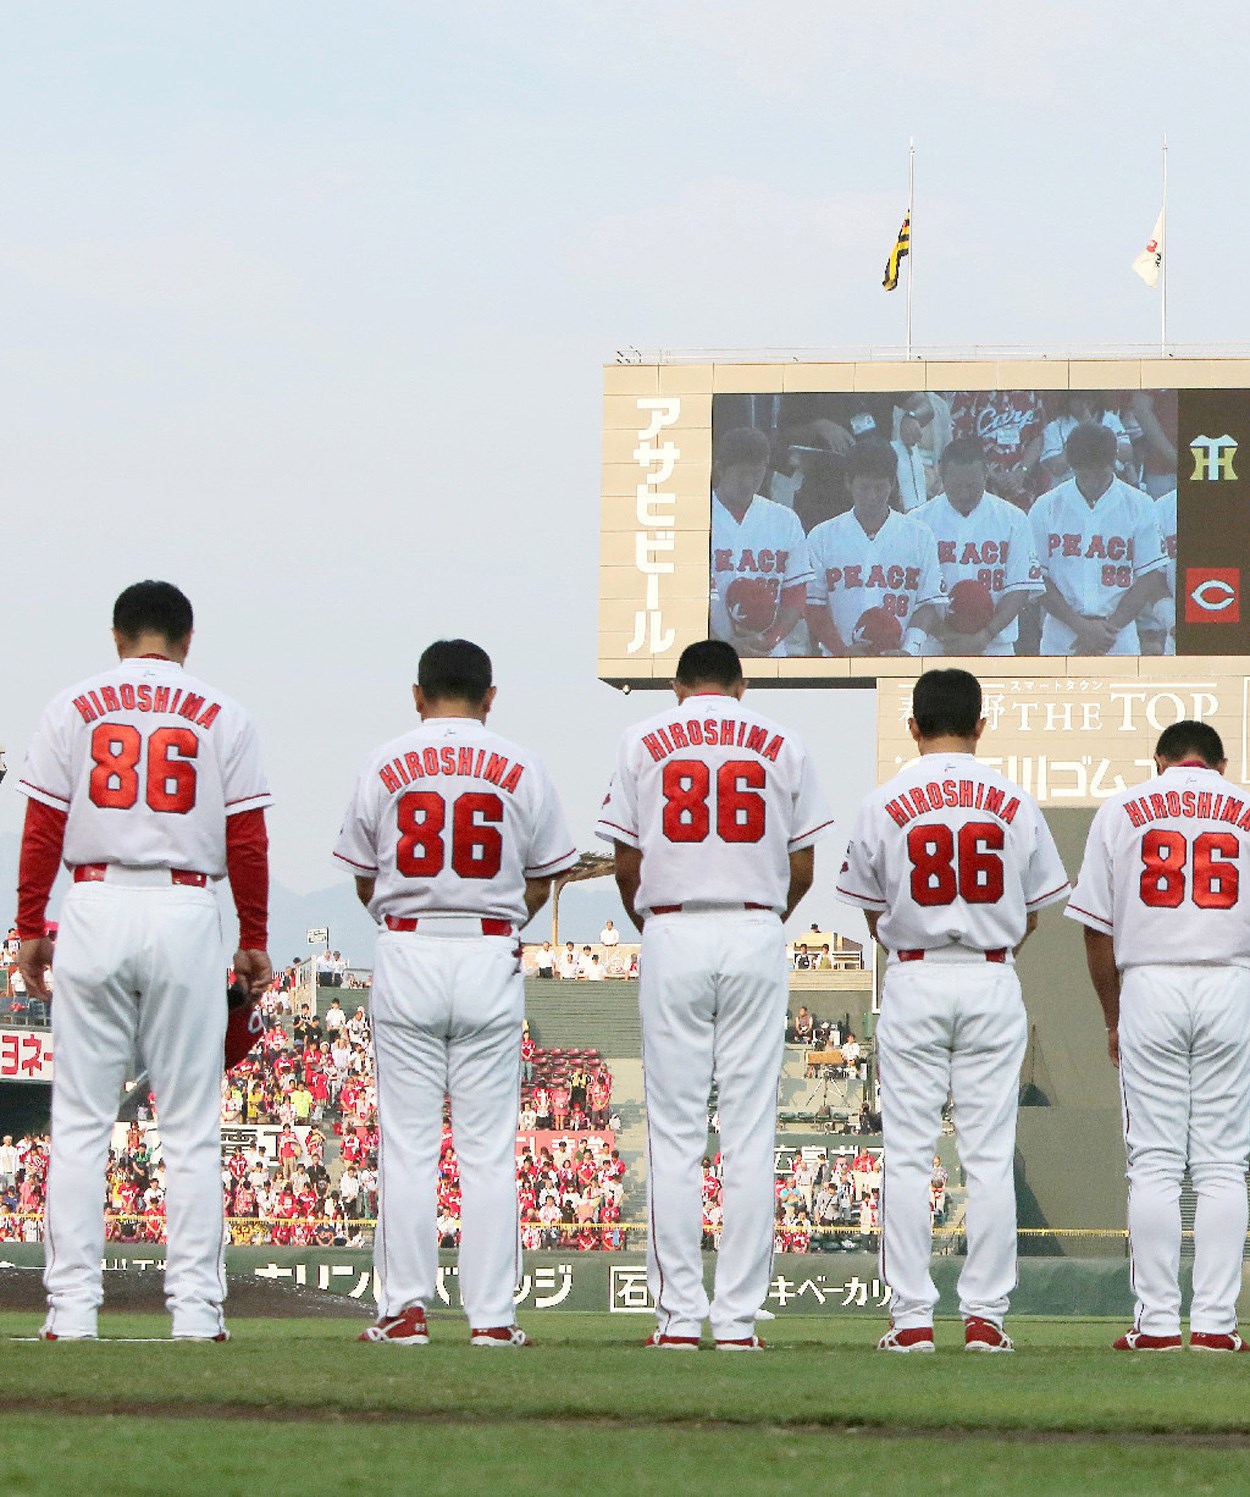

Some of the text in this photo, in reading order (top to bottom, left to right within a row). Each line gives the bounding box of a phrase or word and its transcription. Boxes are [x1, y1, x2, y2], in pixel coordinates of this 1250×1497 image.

[627, 397, 681, 654] アサヒビール
[825, 564, 921, 592] PEACE
[72, 683, 222, 730] HIROSHIMA
[1011, 702, 1102, 731] THE
[1110, 692, 1220, 732] TOP
[88, 722, 200, 815] 86
[379, 746, 525, 795] HIROSHIMA
[641, 718, 785, 763] HIROSHIMA
[661, 758, 767, 844] 86
[884, 779, 1020, 828] HIROSHIMA
[395, 790, 505, 880] 86
[906, 821, 1006, 907] 86
[1140, 828, 1241, 910] 86
